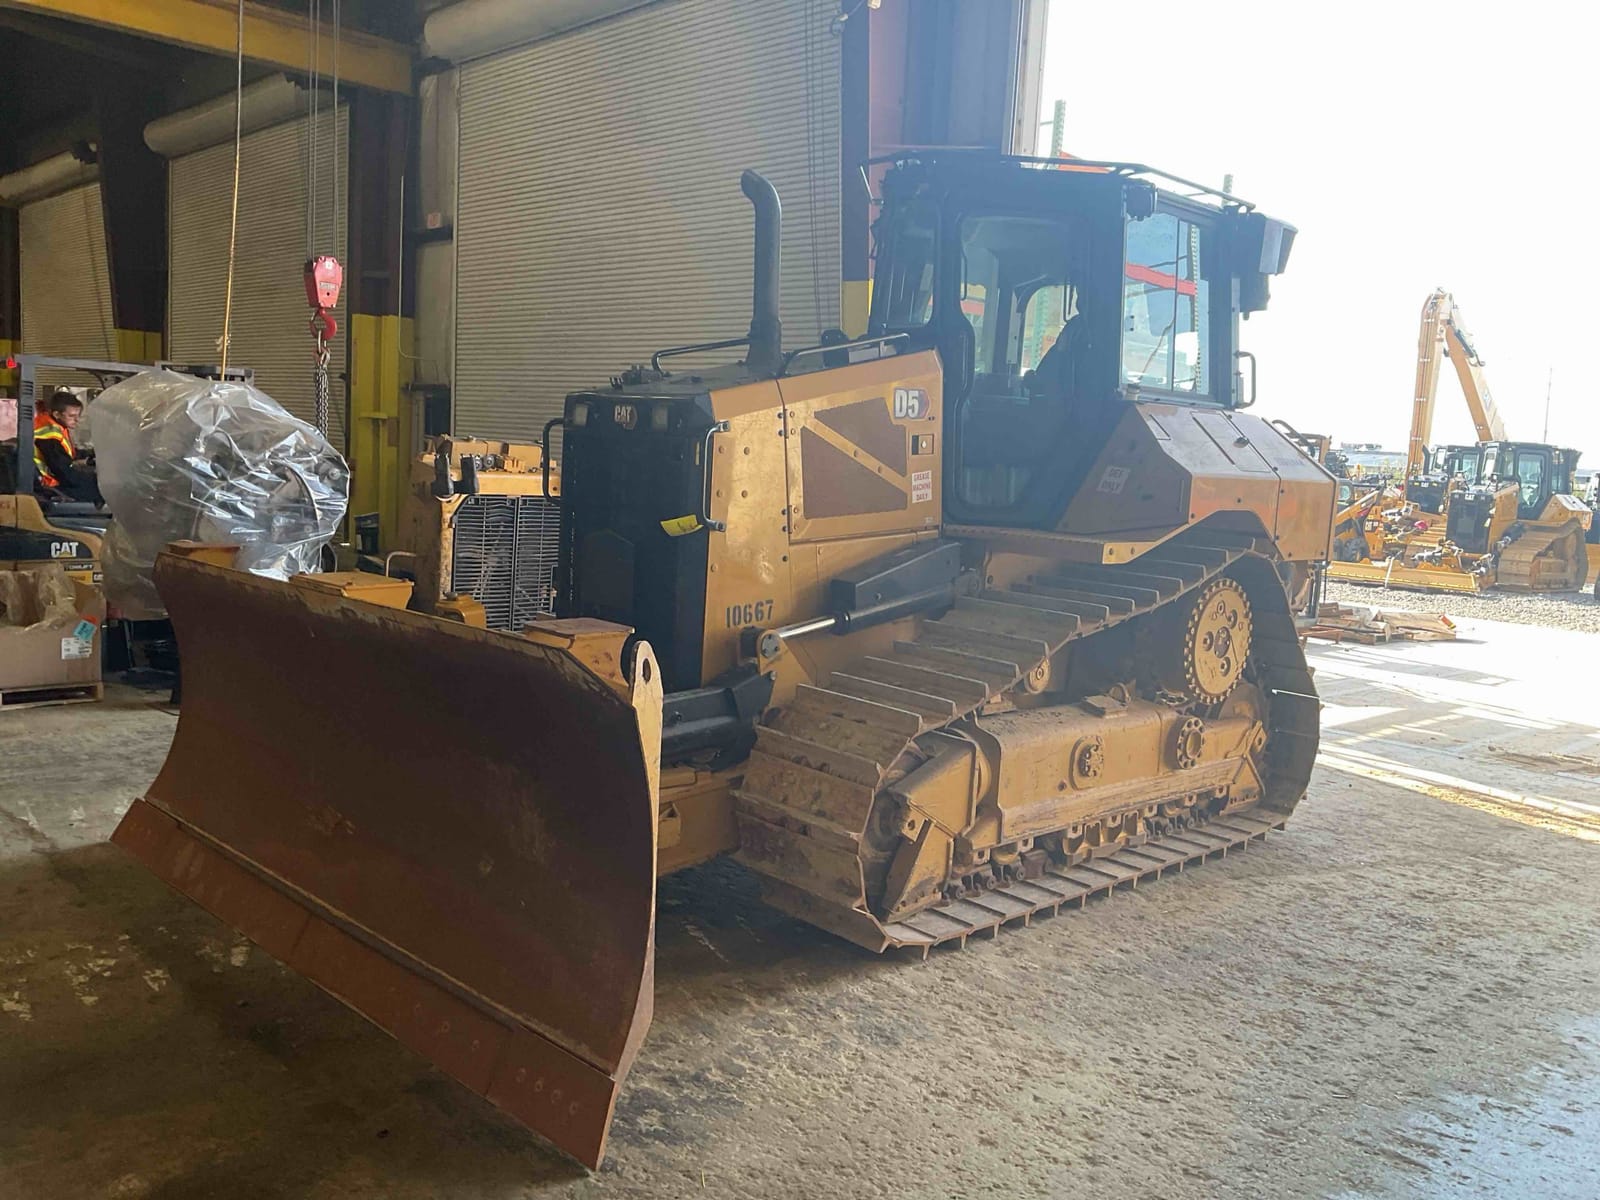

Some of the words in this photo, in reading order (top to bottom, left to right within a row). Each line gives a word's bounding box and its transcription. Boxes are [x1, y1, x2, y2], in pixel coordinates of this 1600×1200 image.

[614, 405, 632, 422] CAT
[895, 389, 919, 418] D5
[50, 541, 79, 558] CAT
[726, 599, 774, 628] 10667
